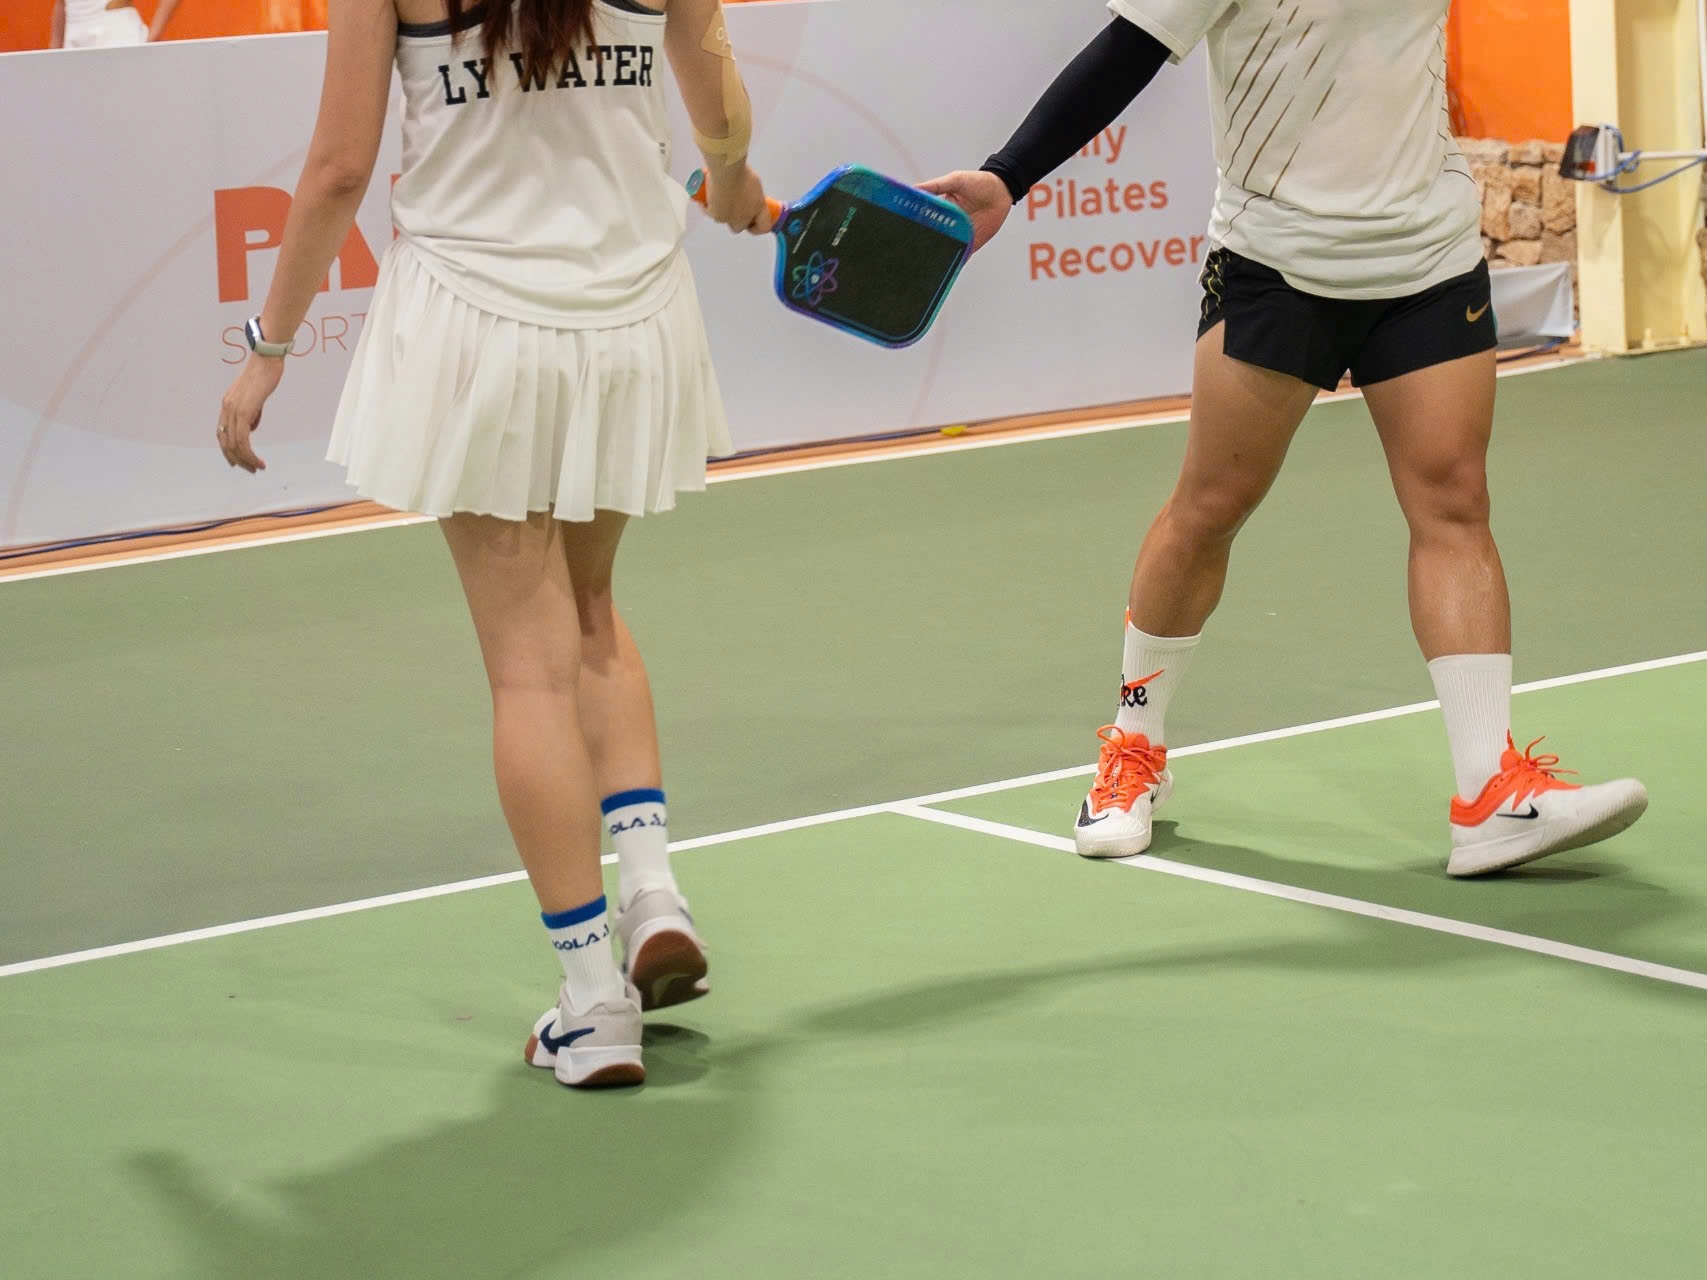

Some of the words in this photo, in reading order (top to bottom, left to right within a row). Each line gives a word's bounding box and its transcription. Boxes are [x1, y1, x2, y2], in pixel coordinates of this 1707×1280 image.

[509, 45, 654, 93] WATER
[1027, 177, 1168, 221] Pilates
[1119, 674, 1148, 708] ke
[553, 932, 601, 951] OOLA
